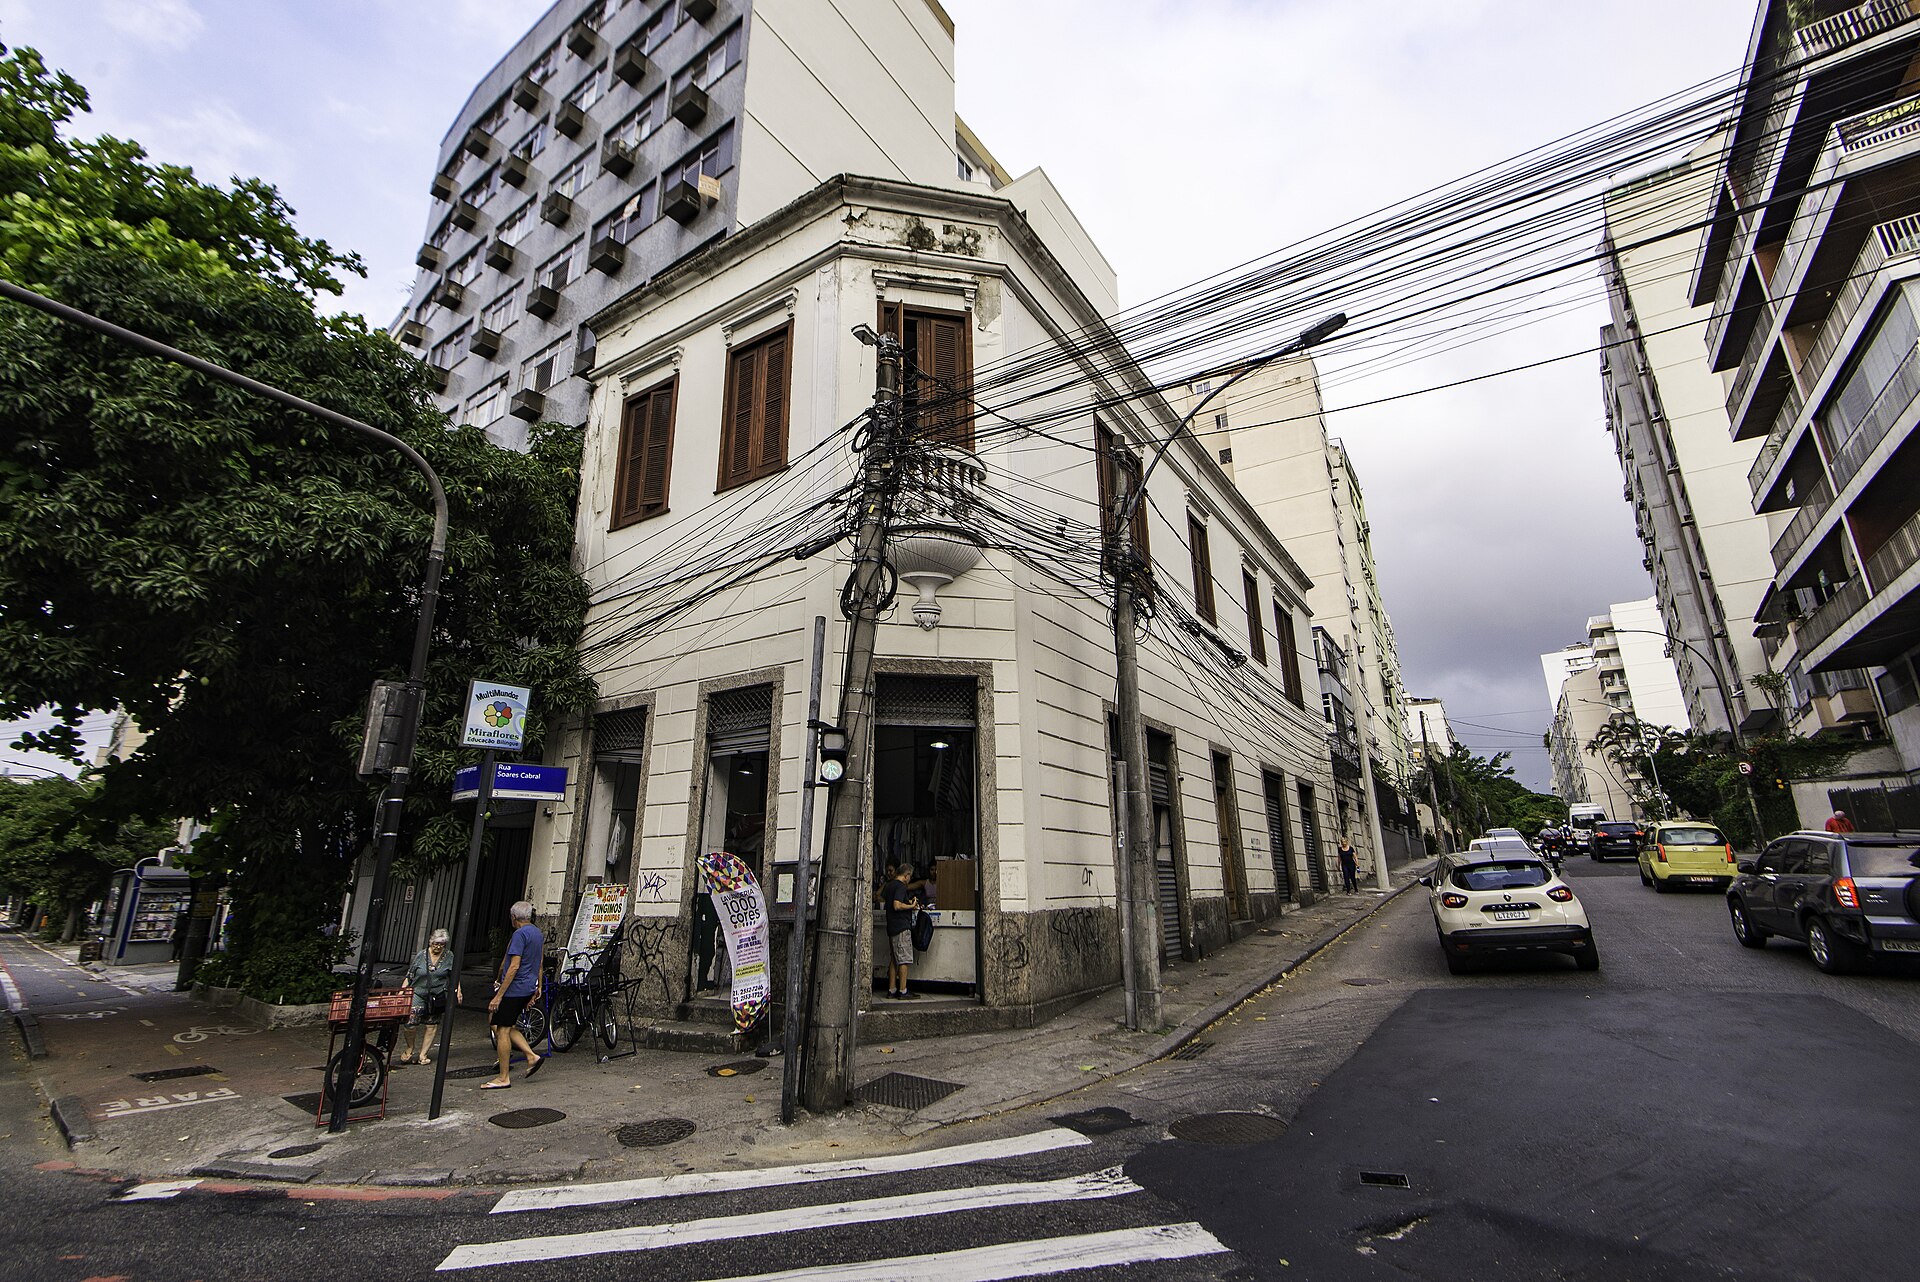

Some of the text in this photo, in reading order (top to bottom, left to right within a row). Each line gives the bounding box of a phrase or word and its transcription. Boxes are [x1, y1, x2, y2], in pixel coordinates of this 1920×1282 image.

[475, 689, 519, 701] MultiMundos
[468, 728, 519, 740] Miraflores
[602, 894, 617, 903] AQUI
[721, 889, 754, 902] LAVANDERIA
[593, 903, 622, 913] TINGIMOS
[723, 896, 757, 915] 1000
[592, 914, 603, 922] SUAS
[730, 909, 760, 924] cores
[99, 1087, 236, 1112] PARE
